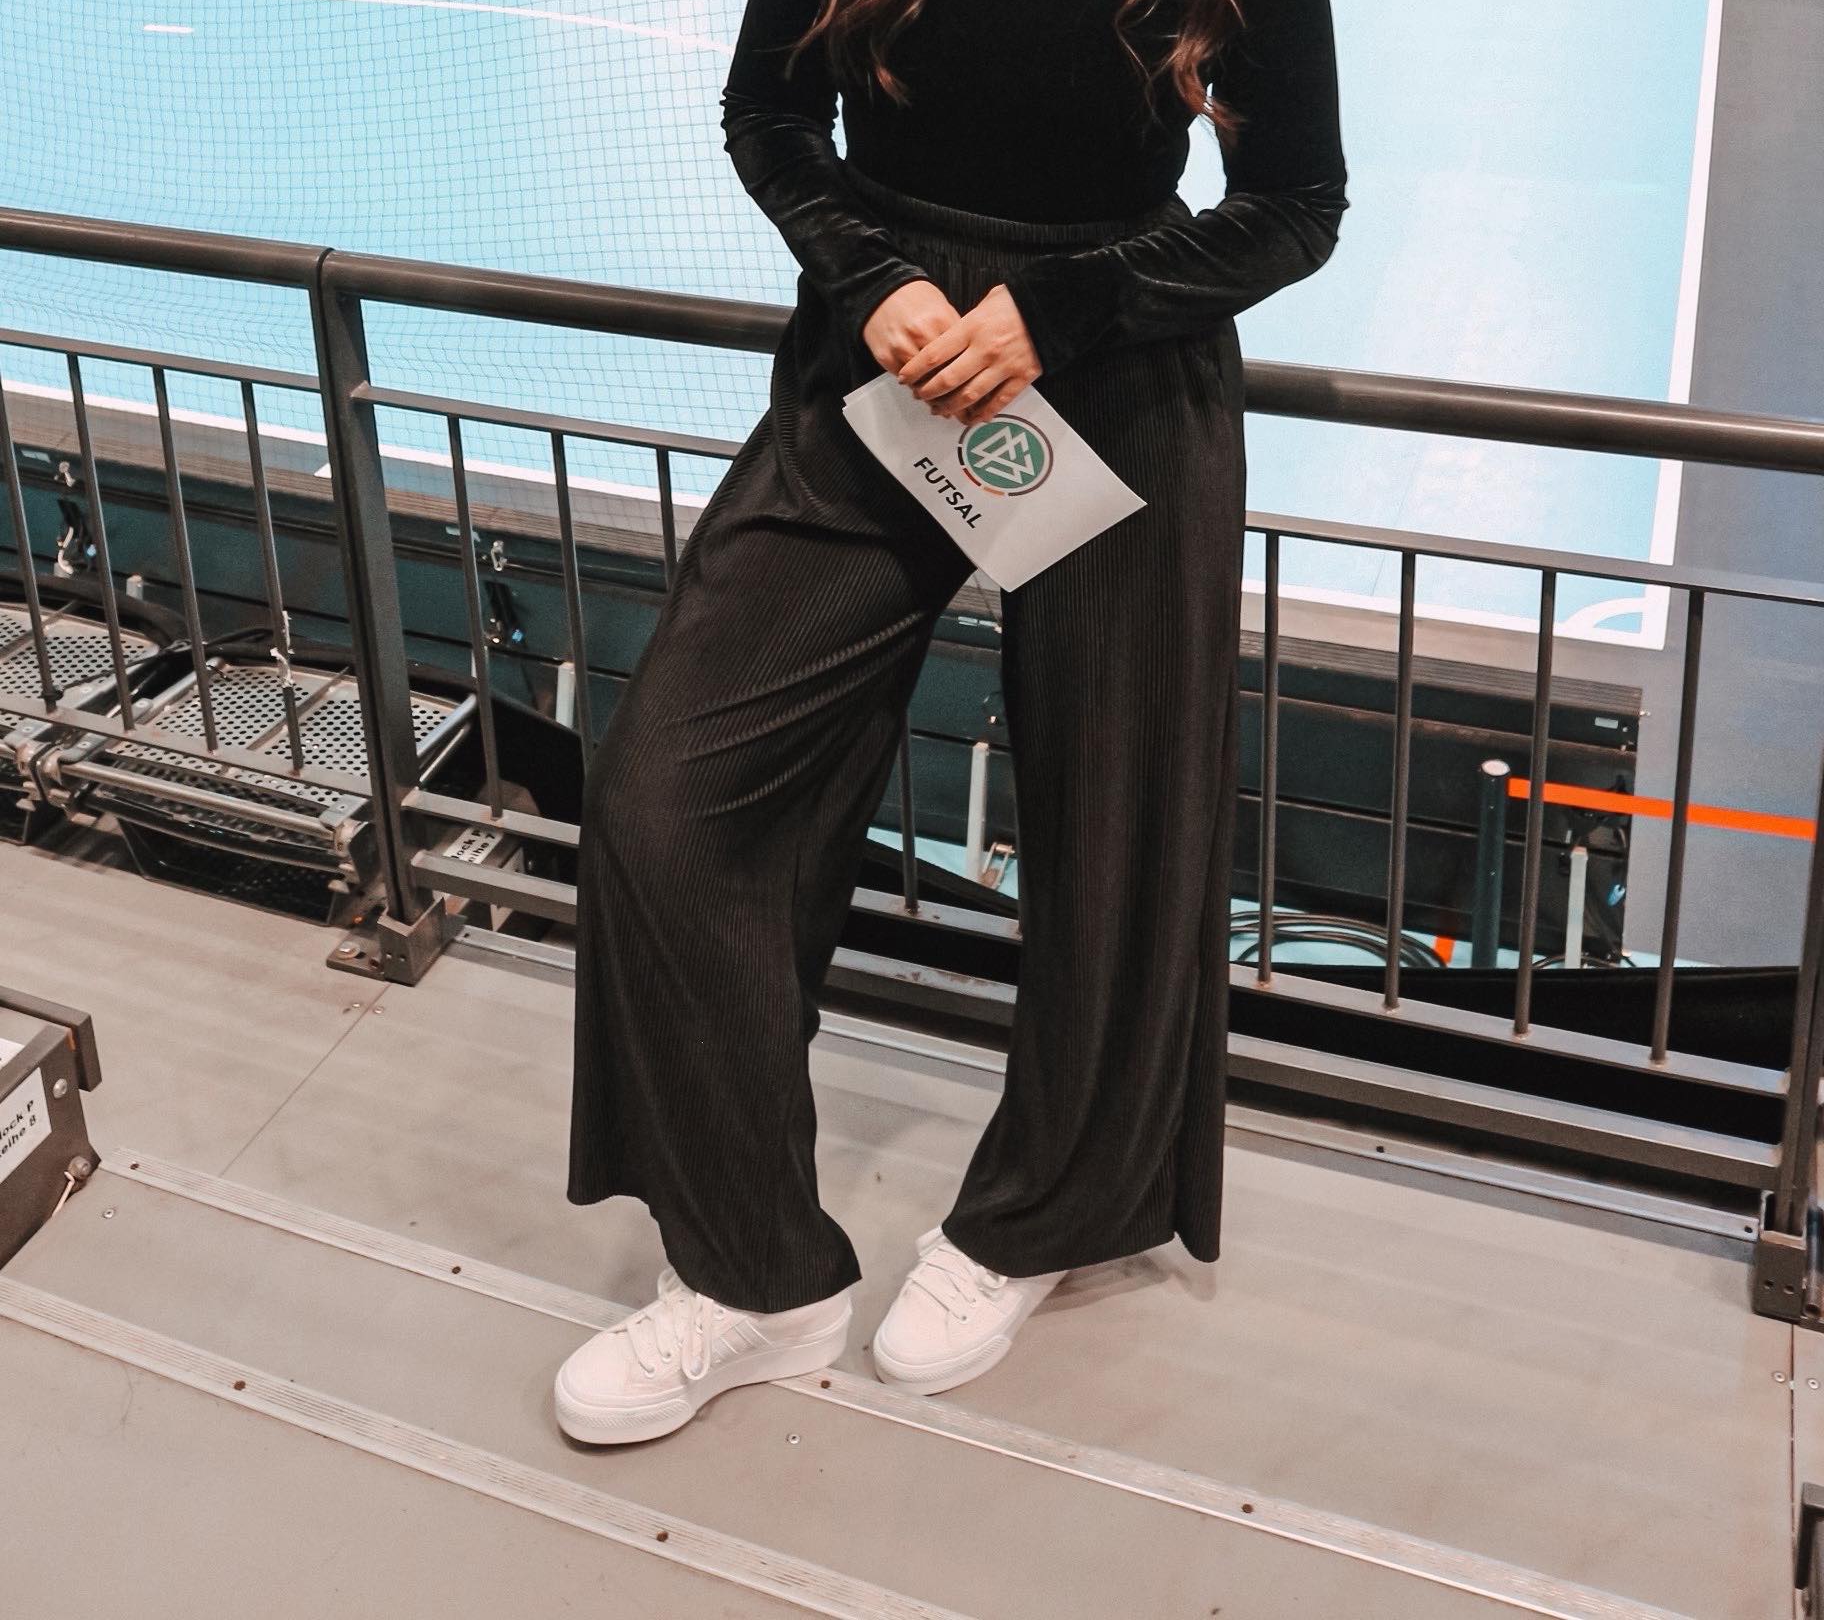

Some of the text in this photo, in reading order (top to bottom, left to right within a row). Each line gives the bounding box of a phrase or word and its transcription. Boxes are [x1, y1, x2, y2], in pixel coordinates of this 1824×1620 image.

[913, 456, 982, 529] FUTSAL
[451, 839, 476, 859] lock
[0, 1100, 34, 1140] lock P
[0, 1127, 26, 1158] eihe
